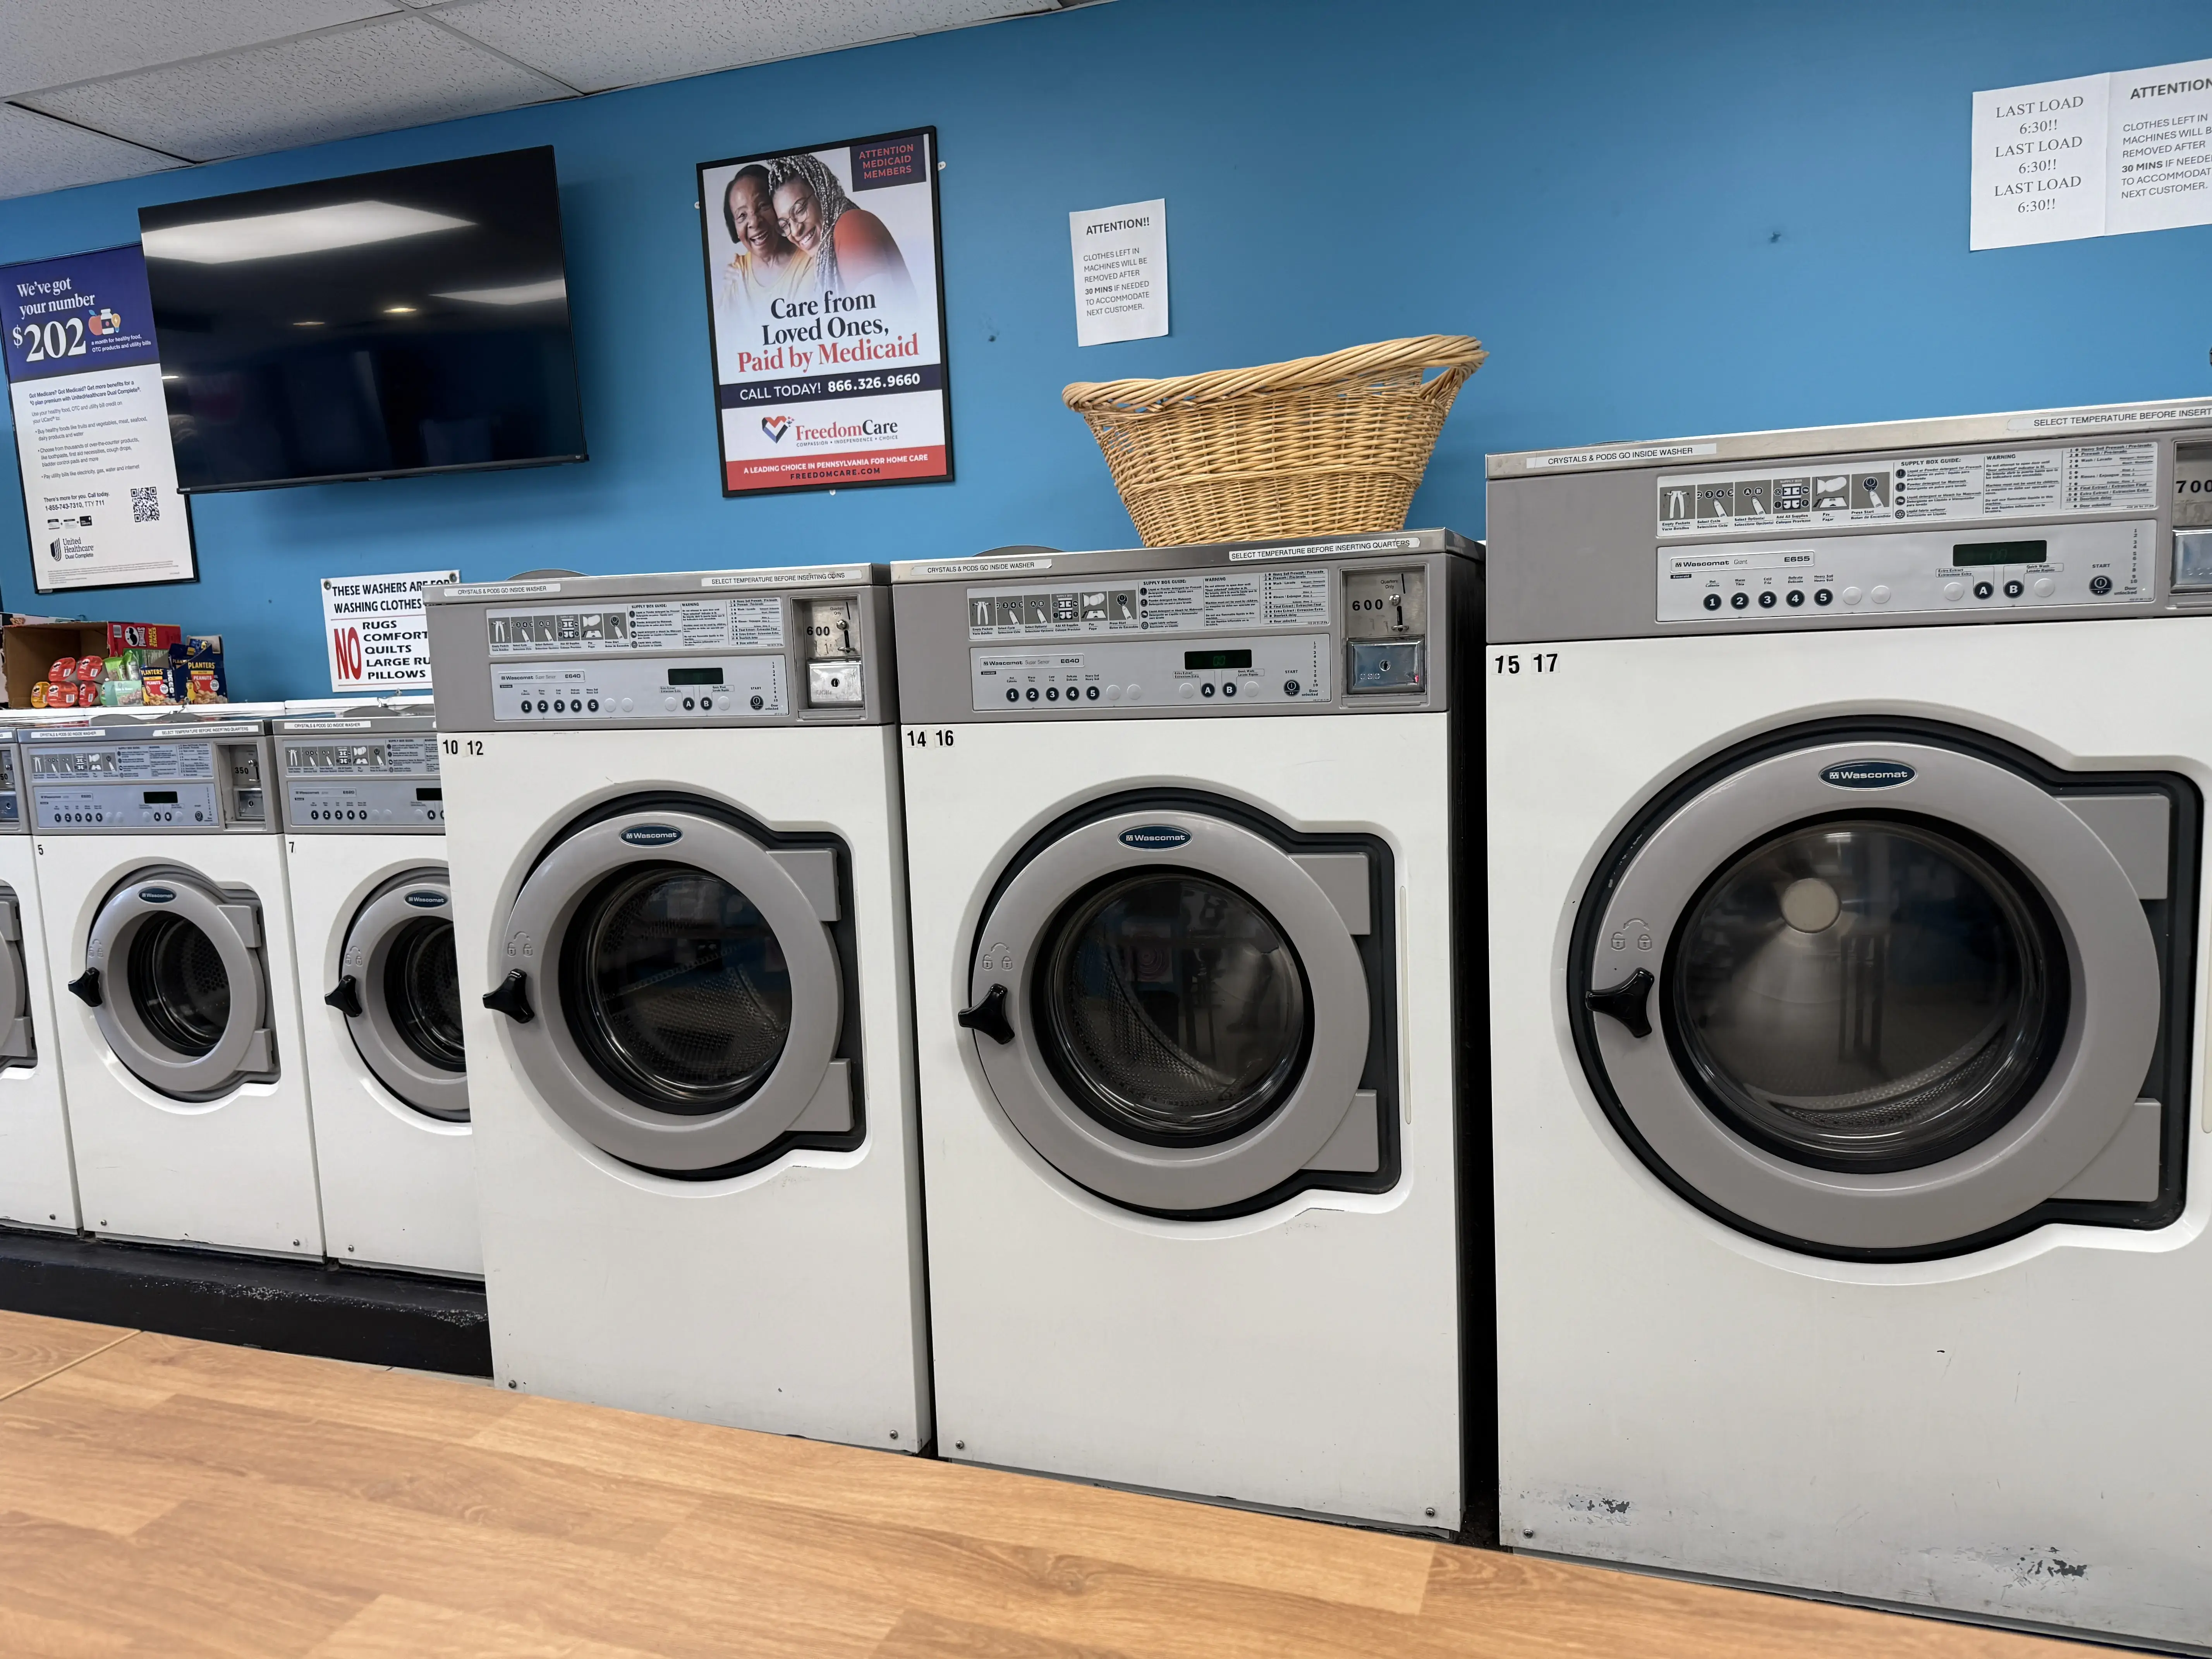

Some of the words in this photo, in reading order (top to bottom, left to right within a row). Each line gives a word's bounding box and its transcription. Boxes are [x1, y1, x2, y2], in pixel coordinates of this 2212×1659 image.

[1996, 103, 2035, 118] LAST
[2039, 96, 2084, 112] LOAD
[2020, 119, 2058, 134] 6:30!!
[2123, 118, 2169, 132] CLOTHES
[2172, 115, 2195, 125] LEFT
[2198, 113, 2208, 122] IN
[2123, 131, 2176, 145] MACHINES
[2179, 128, 2203, 137] WILL
[859, 144, 913, 159] ATTENTION
[1996, 142, 2034, 158] LAST
[2039, 136, 2083, 152] LOAD
[2123, 145, 2172, 158] REMOVED
[2174, 141, 2205, 151] AFTER
[862, 155, 911, 169] MEDICAID
[2019, 159, 2057, 174] 6:30!!
[2136, 161, 2162, 171] MINS
[2166, 159, 2175, 167] IF
[864, 165, 912, 179] MEMBERS
[1994, 182, 2033, 196] LAST
[2037, 175, 2081, 191] LOAD
[2121, 189, 2146, 199] NEXT
[2149, 182, 2208, 196] CUSTOMER.
[2018, 199, 2056, 213] 6:30!!
[1086, 217, 1149, 235] ATTENTION!!
[1084, 252, 1114, 261] CLOTHES
[1084, 261, 1120, 272] MACHINES
[1085, 273, 1118, 283] REMOVED
[1119, 270, 1140, 278] AFTER
[53, 278, 72, 295] got
[1121, 281, 1149, 290] NEEDED
[771, 297, 818, 319] Care
[824, 290, 876, 312] from
[1096, 292, 1149, 304] ACCOMMODATE
[19, 303, 46, 319] your
[48, 293, 95, 312] number
[1104, 304, 1144, 314] CUSTOMER.
[762, 317, 822, 346] Loved
[827, 316, 889, 337] Ones,
[12, 318, 86, 362] $202
[737, 347, 783, 373] Paid
[789, 345, 813, 373] by
[819, 332, 919, 365] Medicaid
[740, 388, 771, 400] CALL
[773, 383, 821, 397] TODAY!
[828, 373, 920, 392] 866.326.9660
[2034, 417, 2068, 426] SELECT
[2070, 413, 2136, 424] TEMPERATURE
[2140, 411, 2176, 420] BEFORE
[796, 419, 898, 441] FreedomCare
[1548, 455, 1587, 465] CRYSTALS
[1632, 450, 1658, 458] INSIDE
[1659, 447, 1692, 456] WASHER
[750, 465, 780, 474] LEADING
[817, 459, 869, 469] PENNSYLVANIA
[790, 467, 881, 480] FREEDOMCARE.COM
[63, 537, 81, 545] United
[64, 545, 94, 553] Healthcare
[1257, 548, 1305, 557] TEMPERATURE
[1335, 542, 1371, 551] INSERTING
[332, 585, 361, 596] THESE
[362, 582, 407, 594] WASHERS
[334, 601, 378, 613] WASHING
[380, 598, 422, 610] CLOTHES
[1352, 599, 1383, 611] 600
[362, 620, 397, 630] RUGS
[807, 626, 830, 636] 600
[334, 627, 362, 680] NO
[365, 645, 412, 654] QUILTS
[366, 658, 410, 667] LARGE
[1495, 655, 1520, 674] 15
[1533, 653, 1558, 672] 17
[368, 670, 426, 680] PILLOWS
[907, 730, 926, 747] 14
[936, 730, 954, 746] 16
[443, 739, 458, 755] 10
[467, 740, 483, 756] 12
[38, 845, 43, 855] 5
[289, 842, 294, 853] 7
